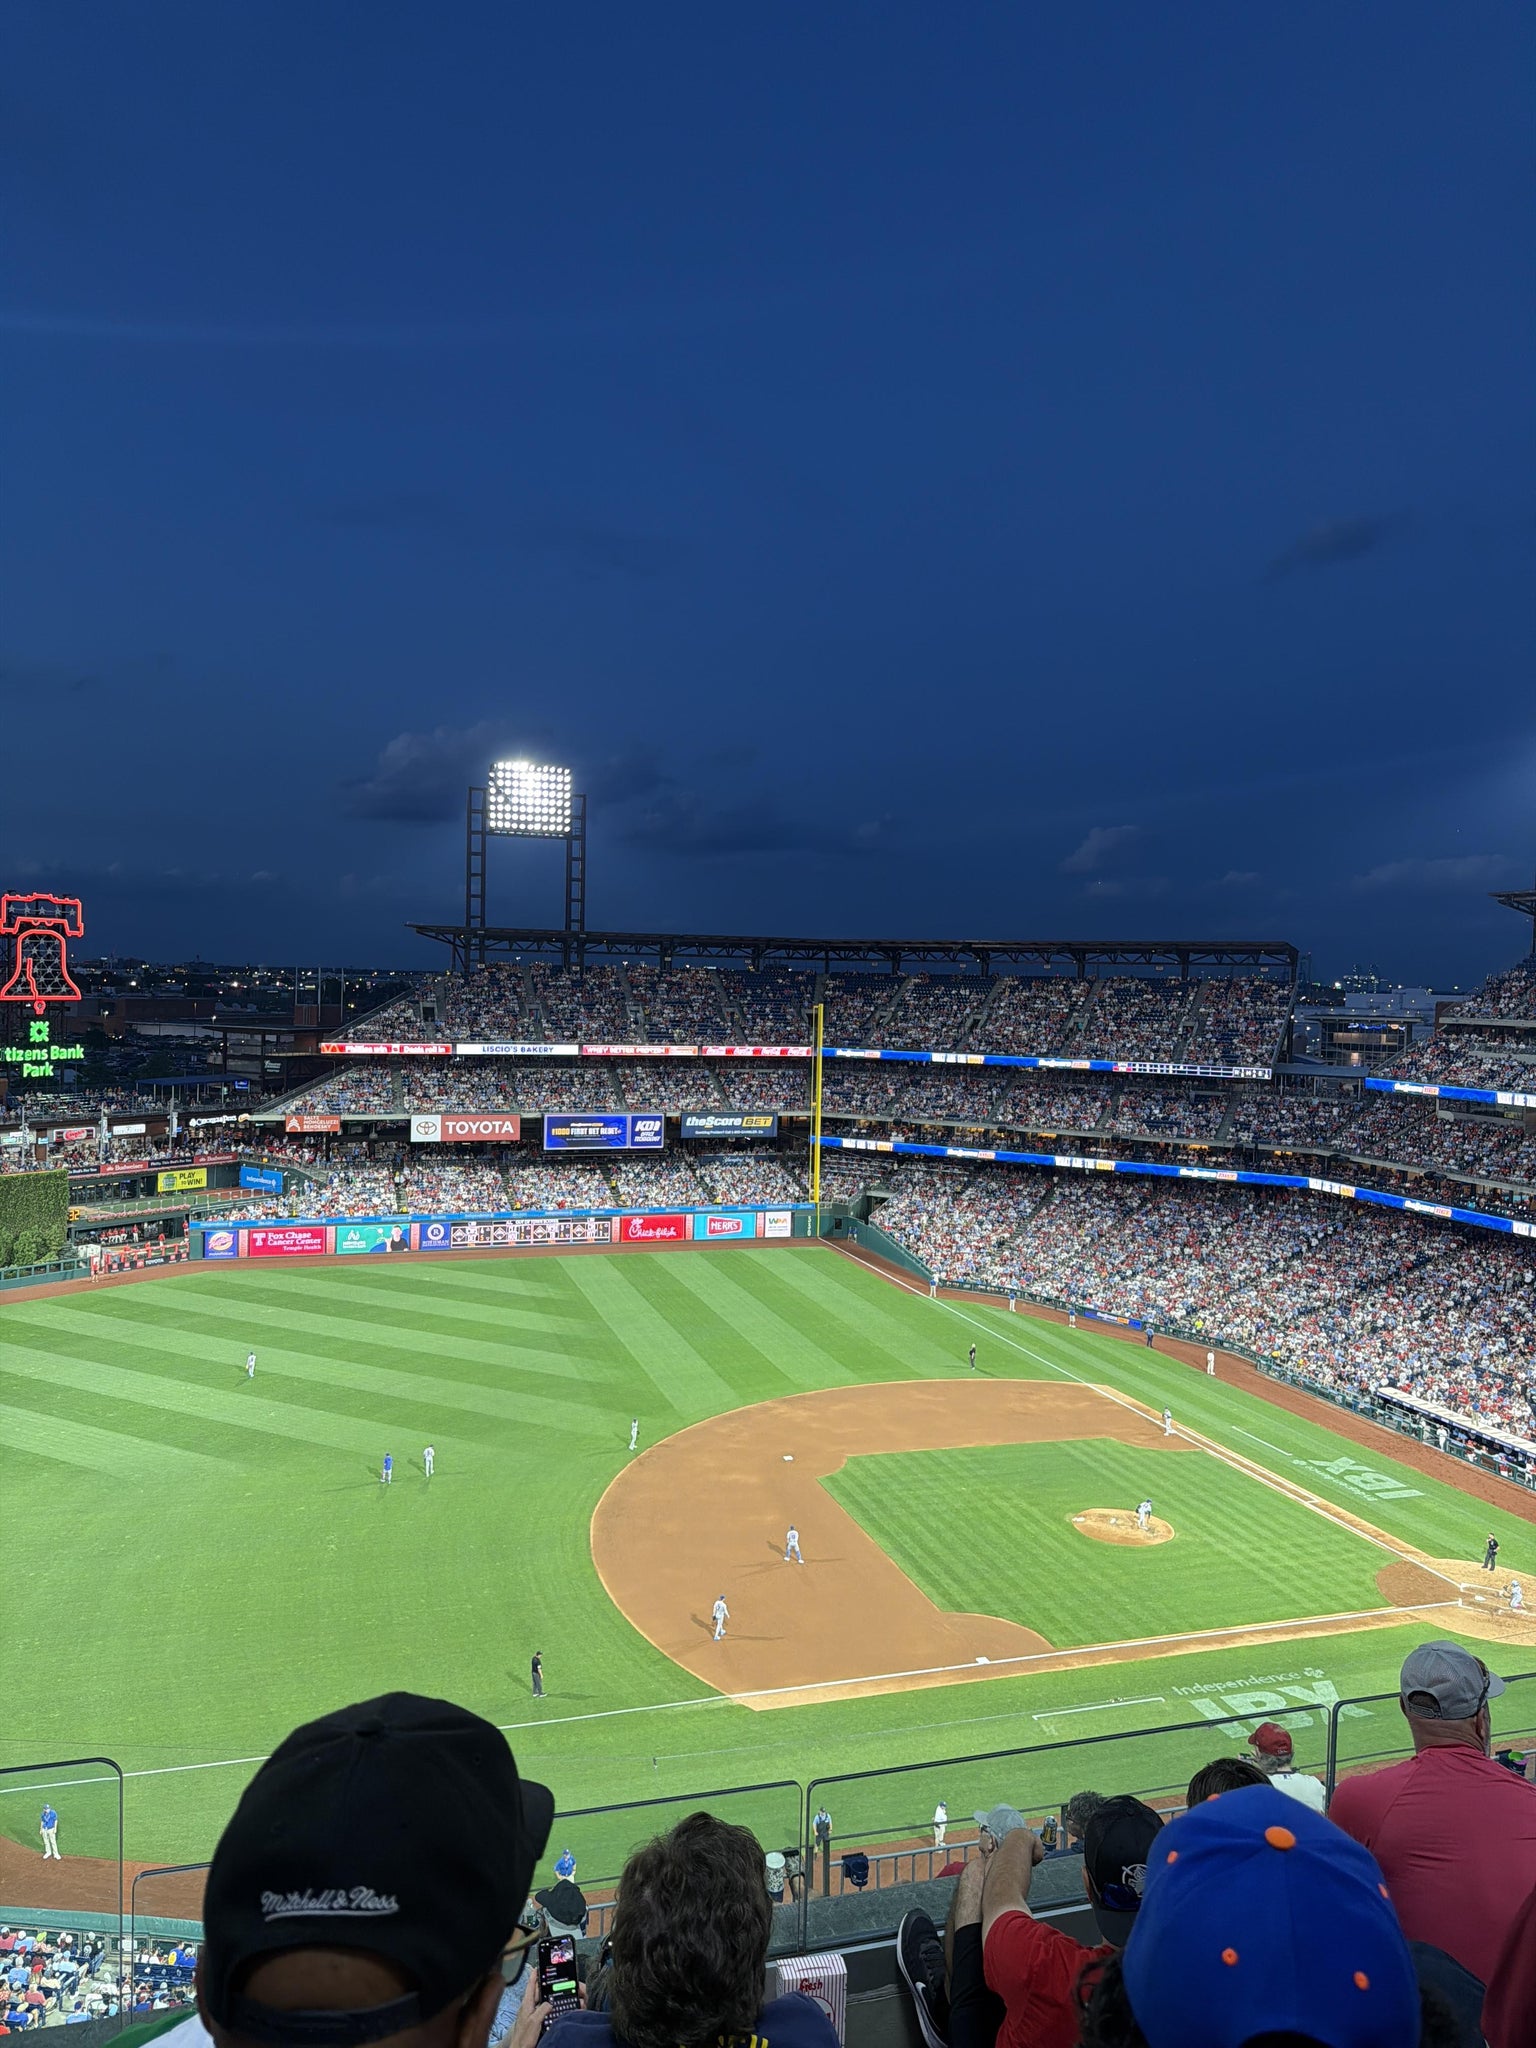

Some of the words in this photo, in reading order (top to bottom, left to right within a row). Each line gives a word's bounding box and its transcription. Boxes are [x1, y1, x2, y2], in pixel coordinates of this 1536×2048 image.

[50, 1044, 85, 1060] Bank
[482, 1045, 518, 1053] LISCIO'S
[520, 1045, 555, 1053] BAKERY
[23, 1061, 54, 1077] Park
[445, 1120, 514, 1135] TOYOTA
[686, 1116, 742, 1127] theScore
[180, 1171, 196, 1179] PLAY
[268, 1232, 284, 1240] Fox
[285, 1231, 311, 1239] Chase
[268, 1238, 295, 1246] Cancer
[296, 1237, 321, 1245] Center
[1171, 1671, 1301, 1696] Independence
[1189, 1680, 1375, 1739] IBX
[261, 1888, 331, 1913] Mitchell
[332, 1889, 348, 1909] &
[349, 1886, 399, 1911] Ness
